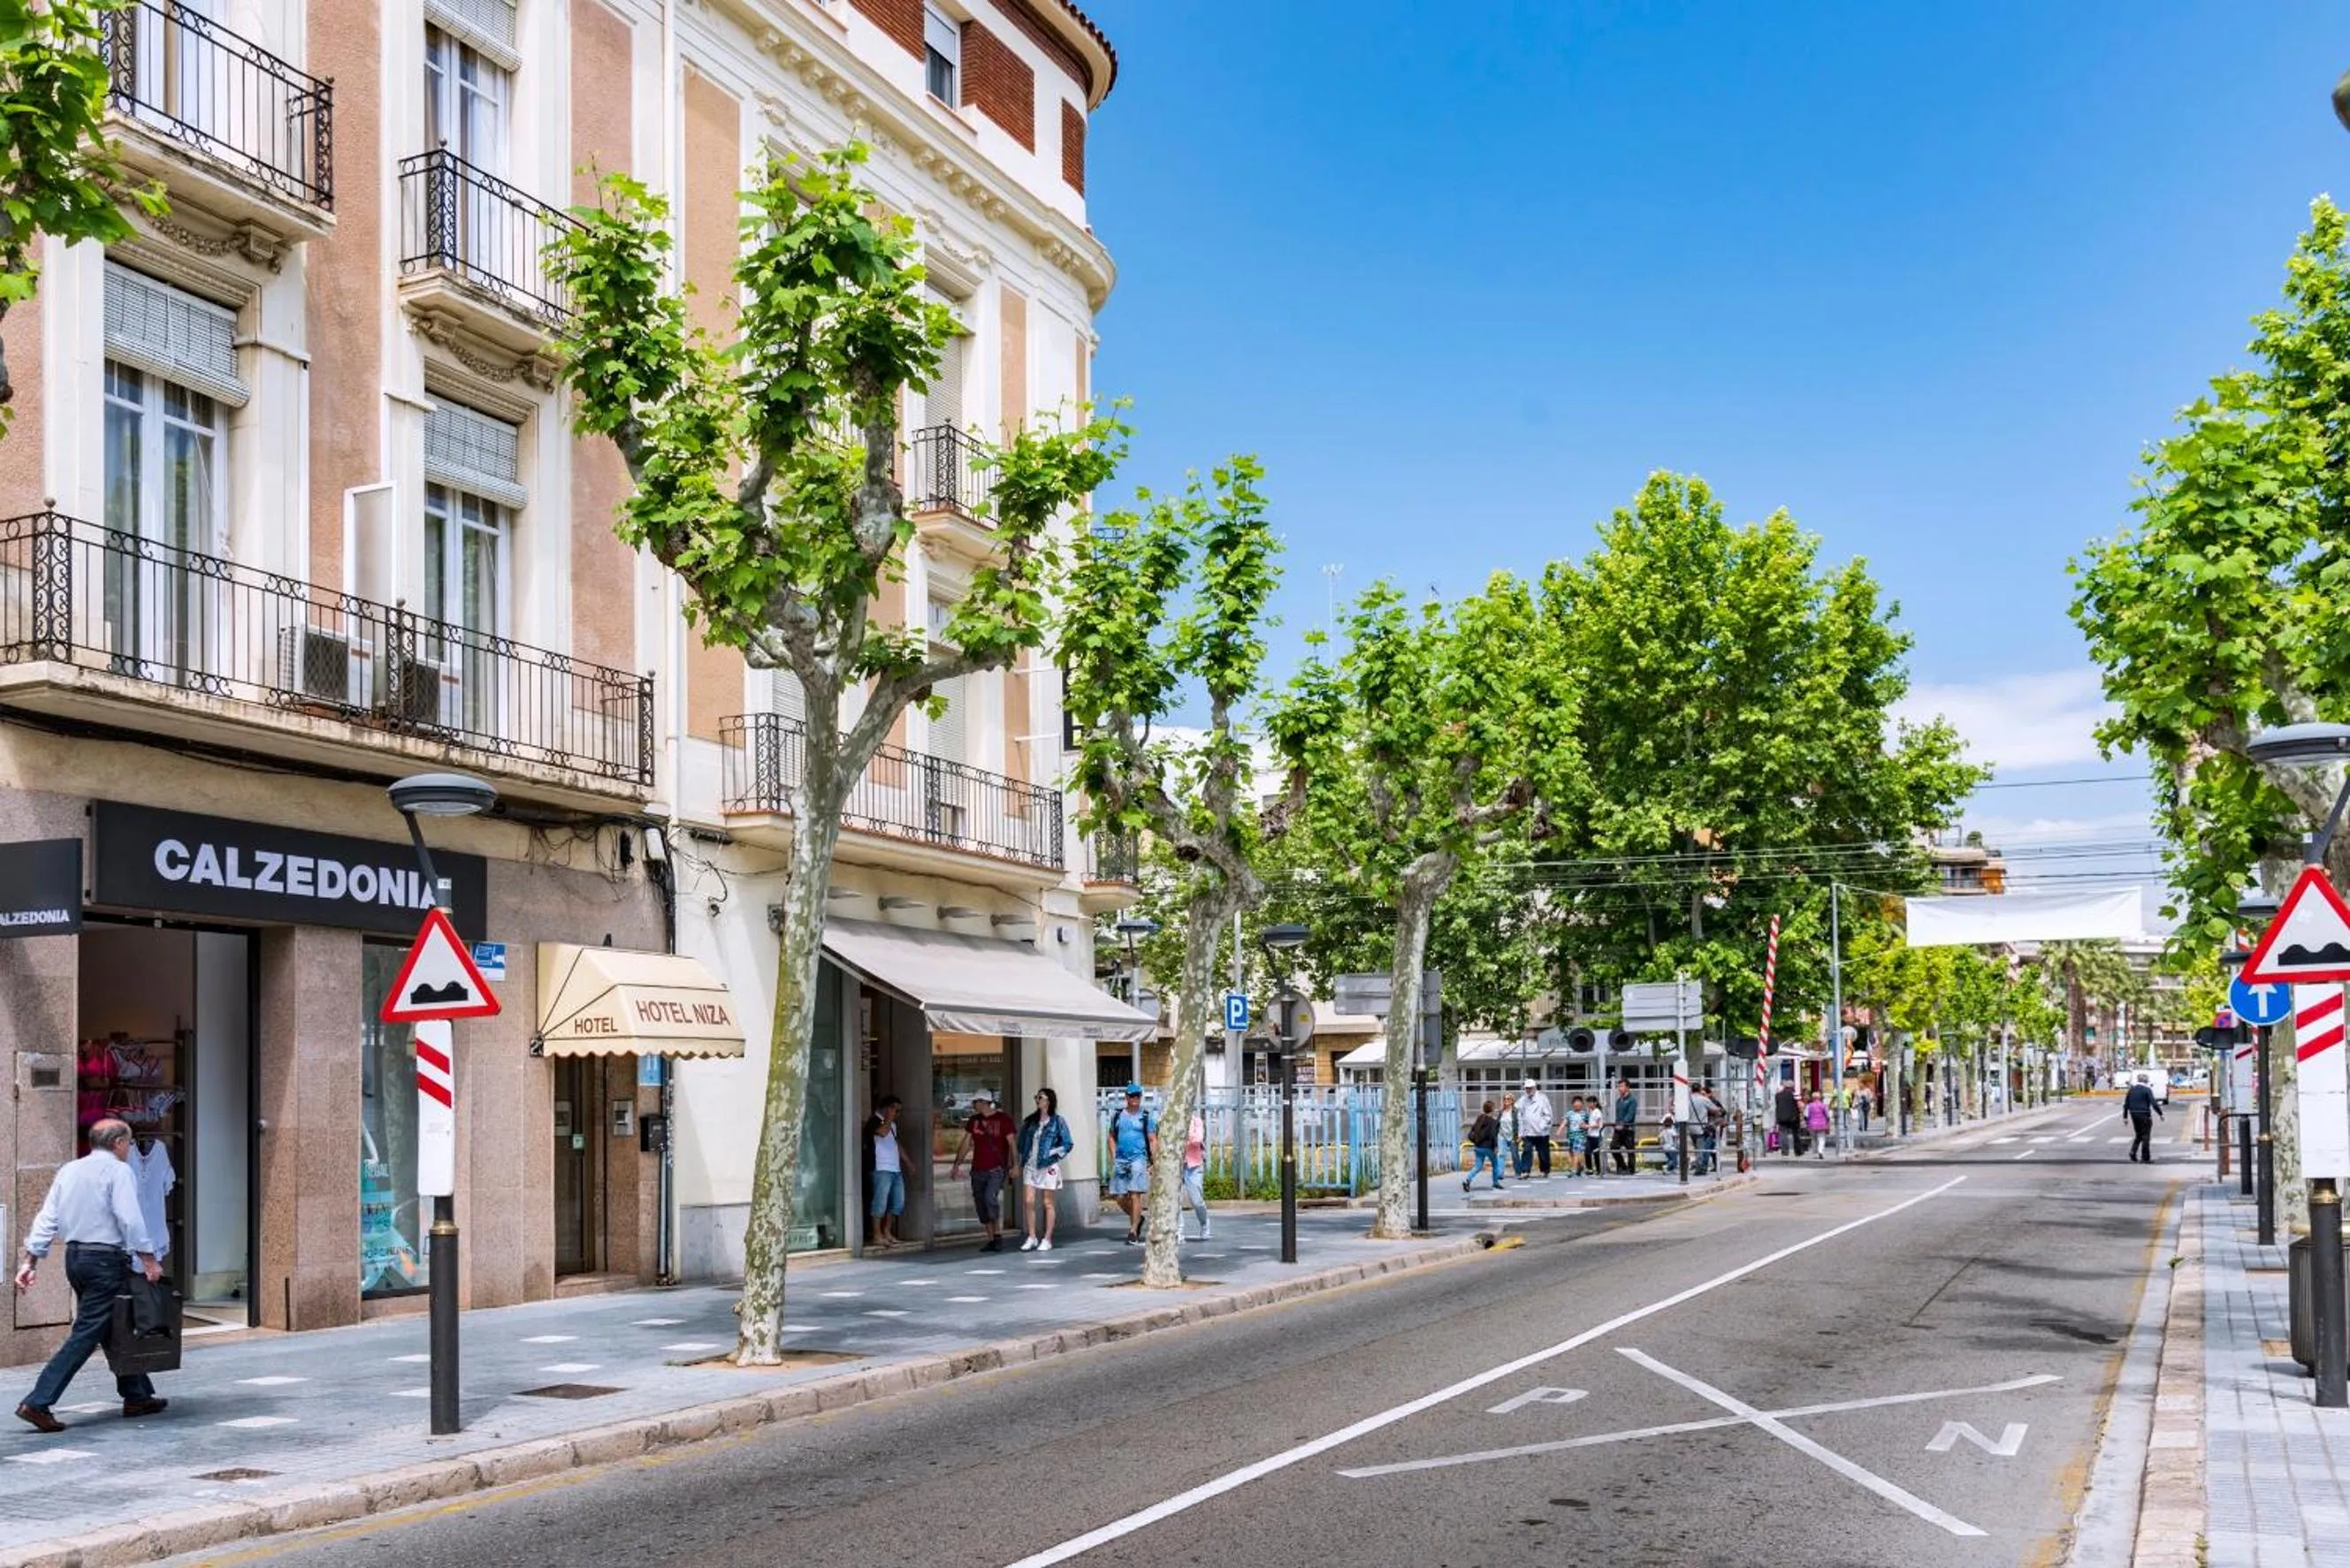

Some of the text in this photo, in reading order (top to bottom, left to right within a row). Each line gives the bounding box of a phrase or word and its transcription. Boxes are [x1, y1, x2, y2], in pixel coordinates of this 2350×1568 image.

[635, 1000, 732, 1025] HOTEL NIZA
[1230, 998, 1244, 1026] P
[575, 1017, 619, 1035] HOTEL
[1485, 1387, 1590, 1414] P
[1925, 1420, 2029, 1457] N
